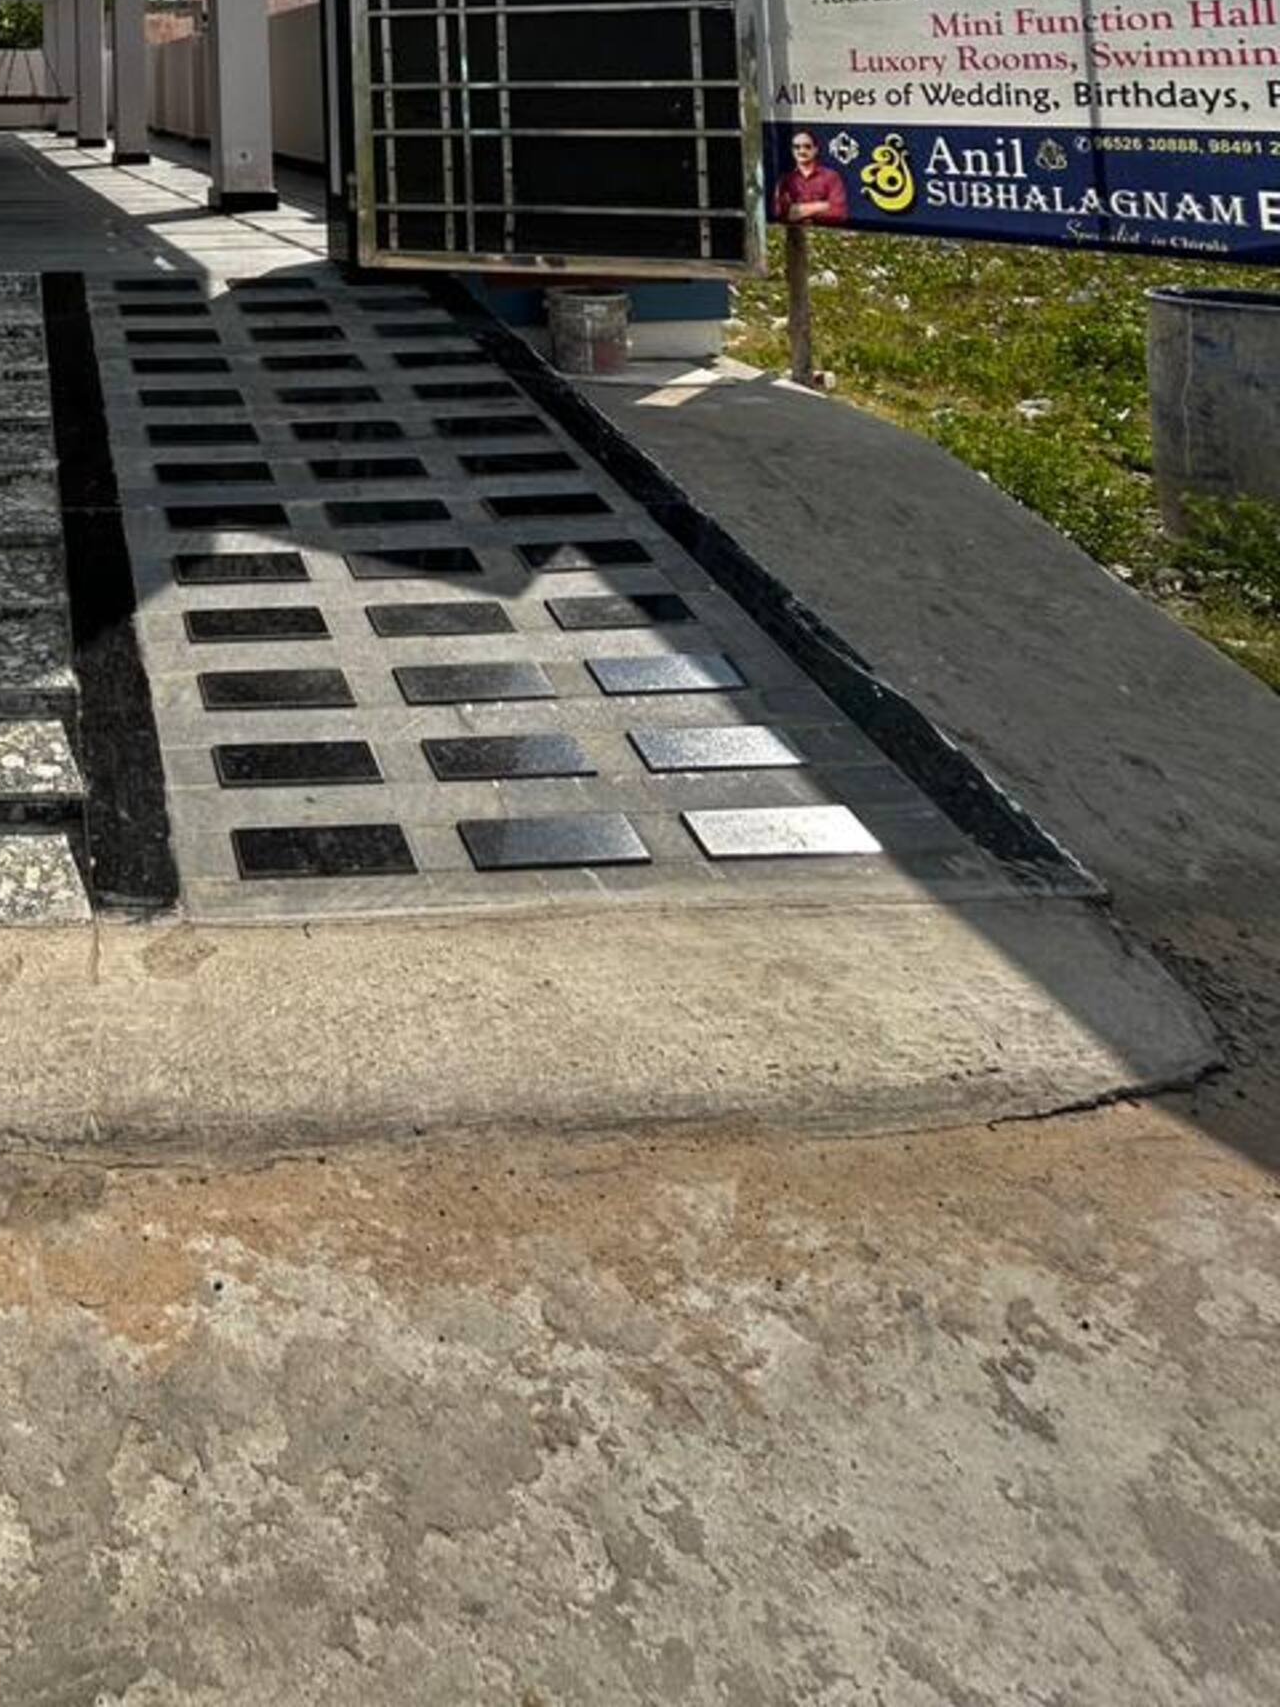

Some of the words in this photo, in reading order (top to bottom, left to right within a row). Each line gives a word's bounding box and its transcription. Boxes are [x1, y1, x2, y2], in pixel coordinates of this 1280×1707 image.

[931, 11, 1004, 38] Mini
[1015, 4, 1174, 36] Function
[849, 48, 948, 76] Luxory
[957, 45, 1078, 74] Rooms,
[775, 82, 805, 106] All
[815, 85, 878, 112] types
[885, 82, 913, 106] of
[921, 81, 1062, 114] Wedding,
[1073, 80, 1251, 115] Birthdays,
[924, 136, 1028, 178] Anil
[926, 179, 1249, 227] SUBHALAGNAM
